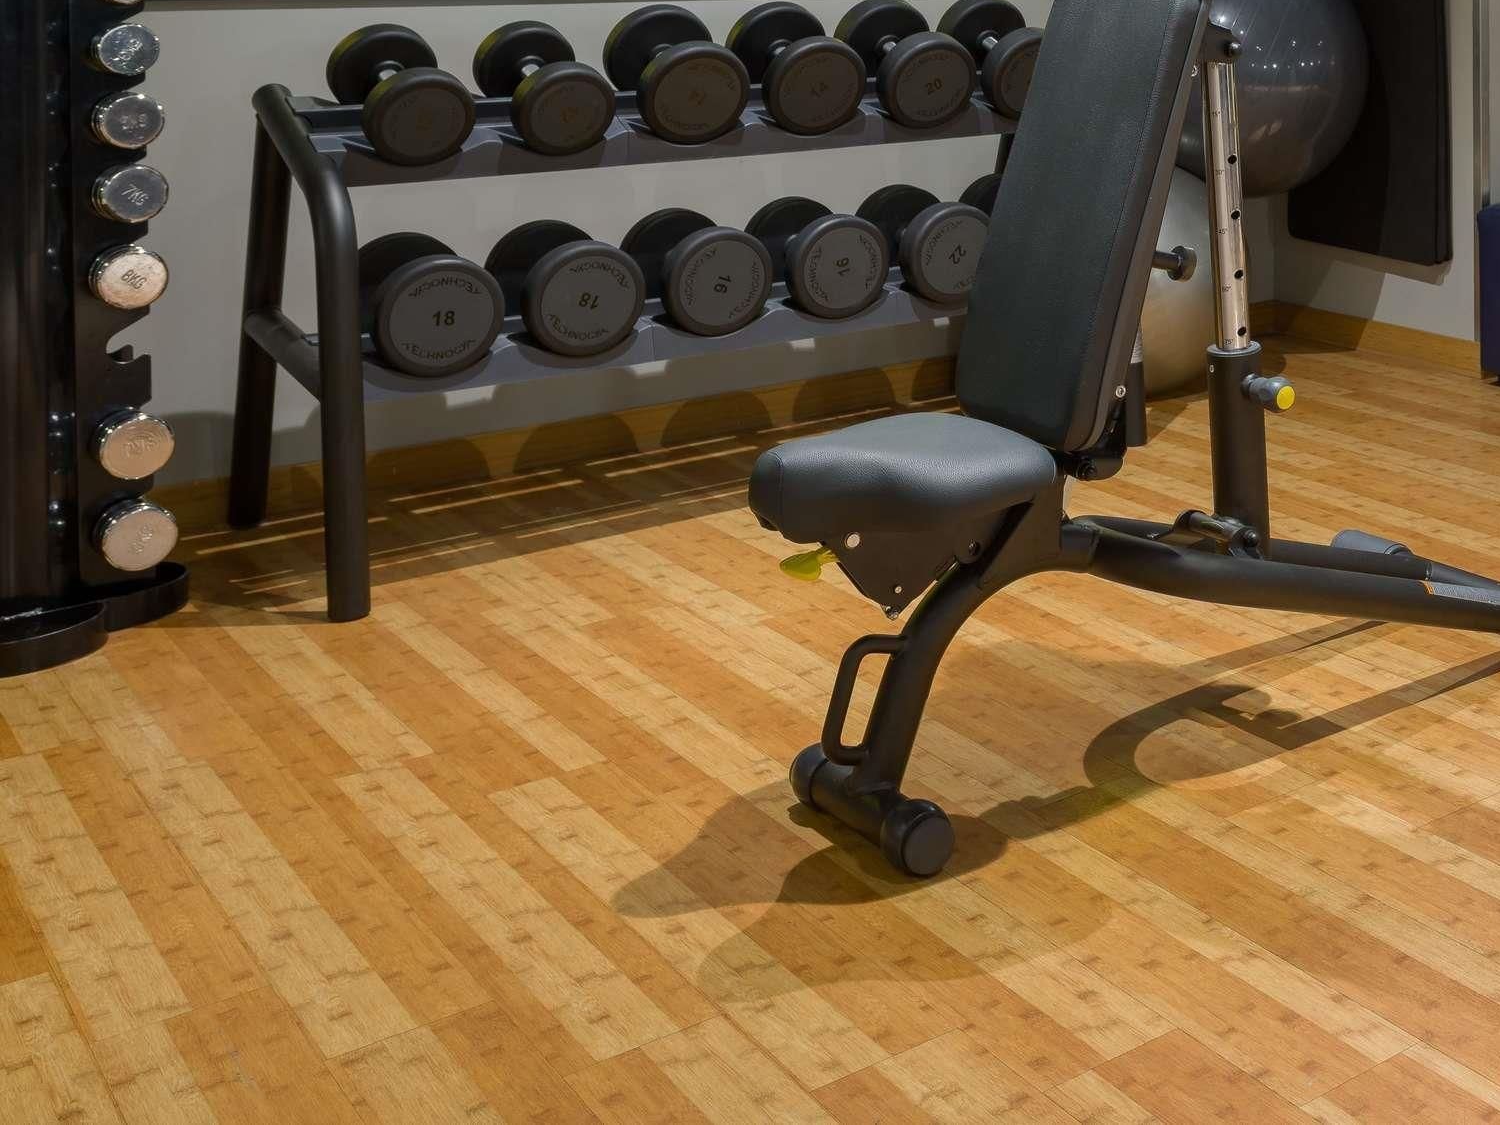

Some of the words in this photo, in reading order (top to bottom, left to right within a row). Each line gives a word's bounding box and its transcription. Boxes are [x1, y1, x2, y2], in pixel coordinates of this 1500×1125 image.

[924, 77, 943, 95] 20
[949, 244, 967, 265] 22
[835, 257, 850, 276] 16
[714, 274, 732, 294] 16
[579, 292, 600, 310] 18
[432, 311, 455, 327] 18
